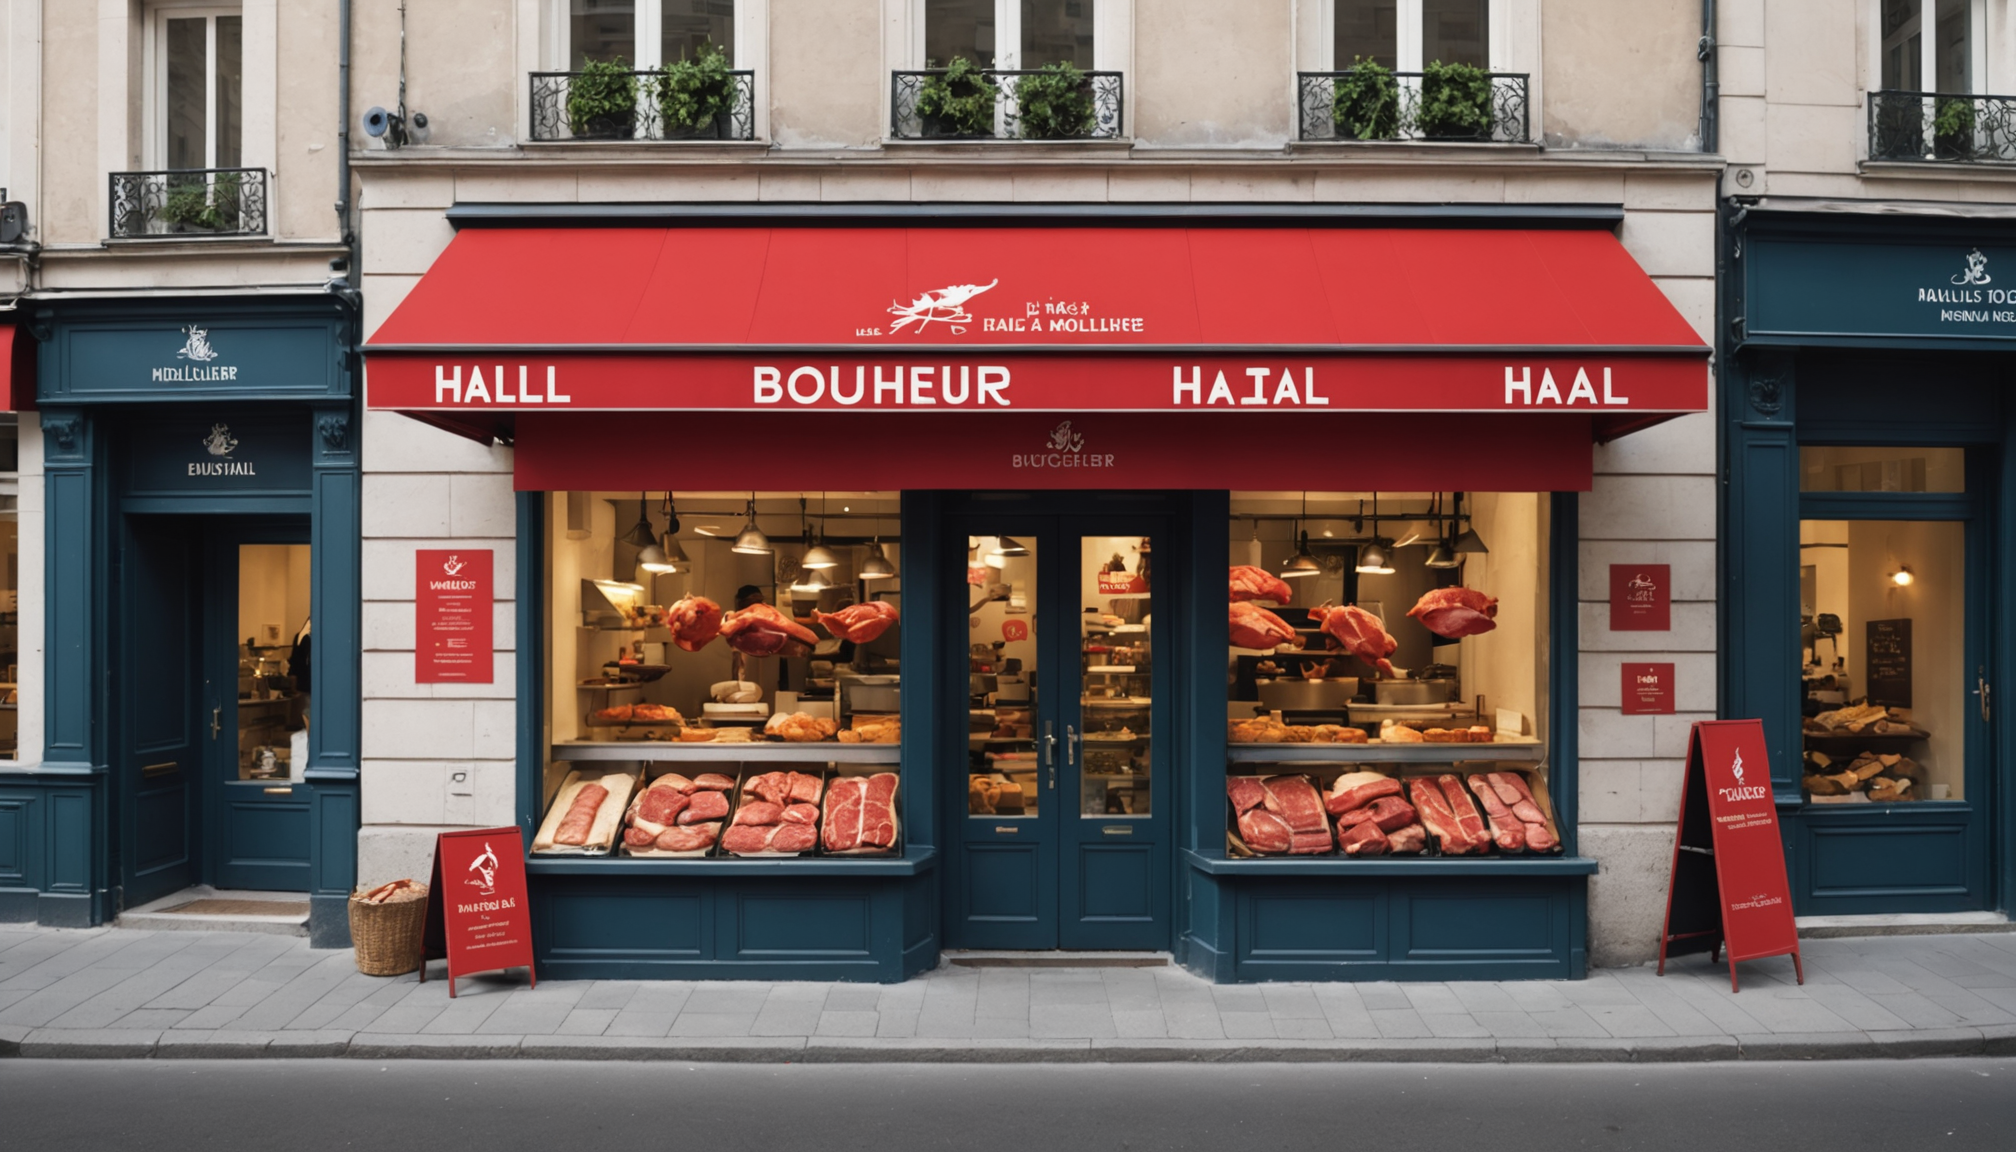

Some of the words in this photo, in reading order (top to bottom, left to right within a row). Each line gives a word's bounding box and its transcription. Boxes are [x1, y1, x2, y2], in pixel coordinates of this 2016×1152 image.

[435, 365, 570, 403] HALLL
[753, 366, 1011, 405] BOUHEUR
[1504, 367, 1628, 404] HAAL
